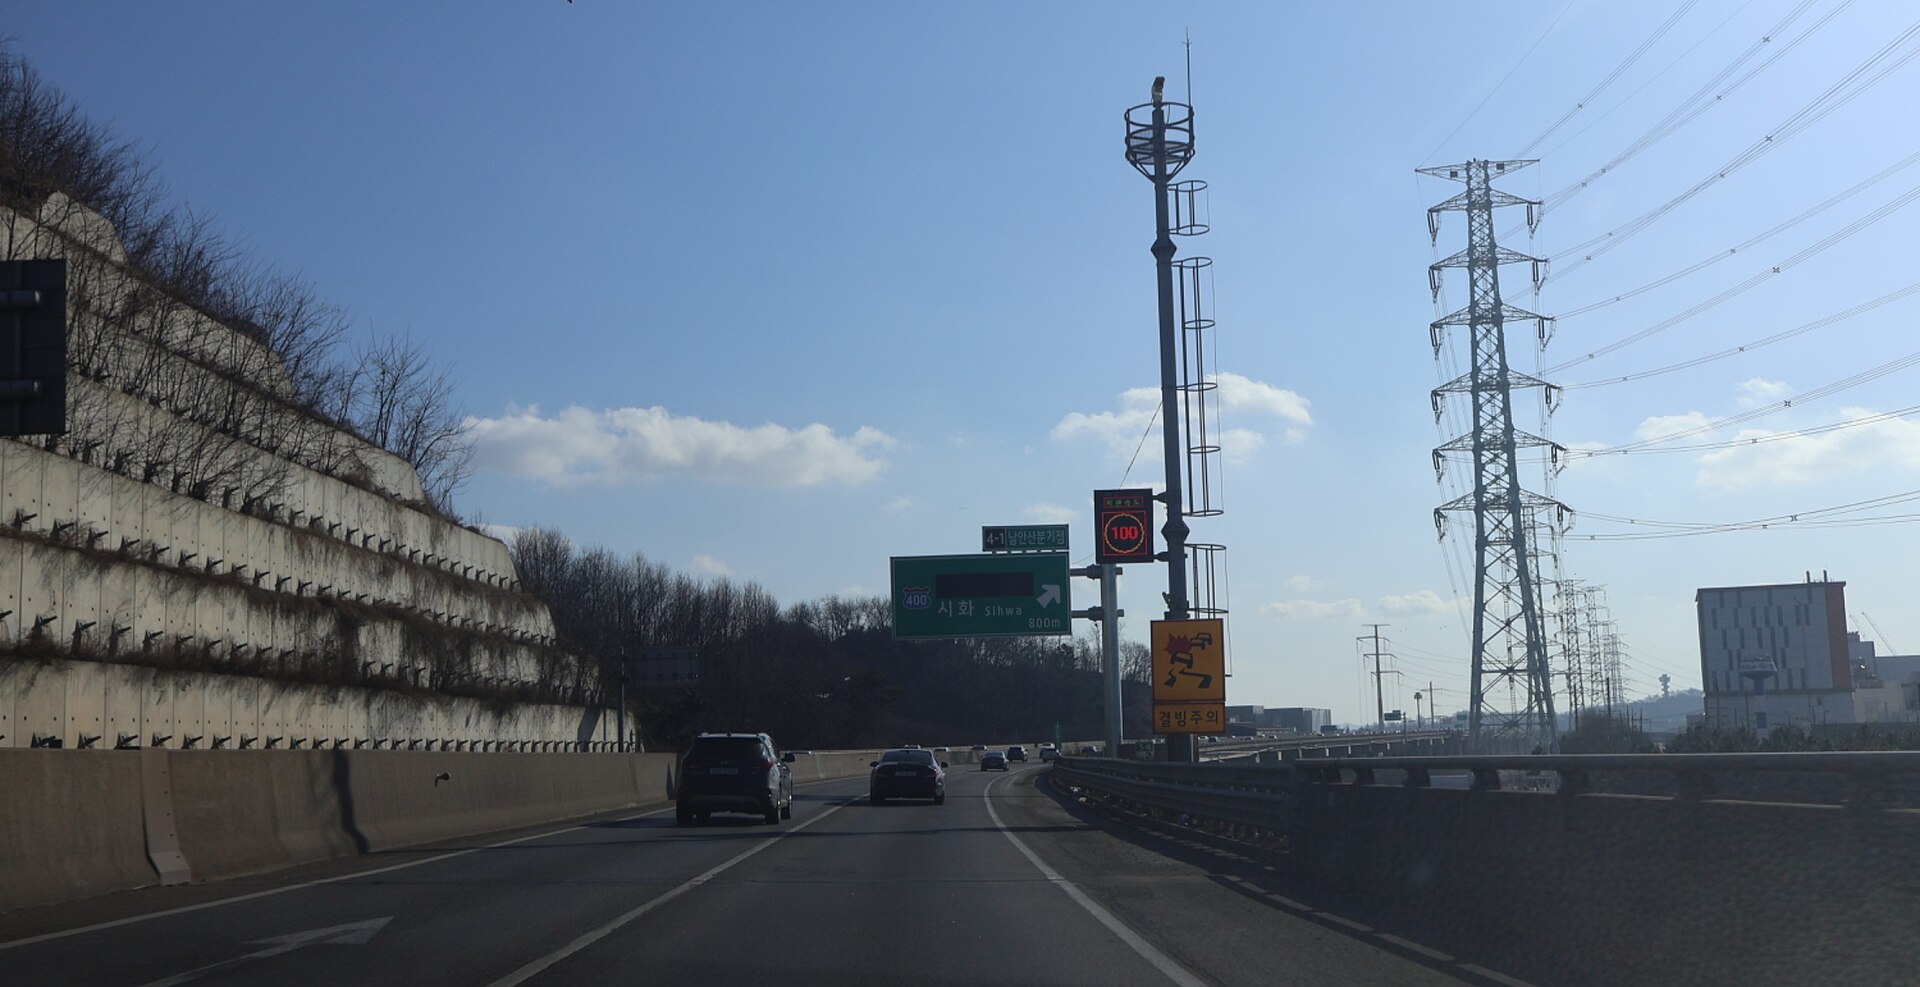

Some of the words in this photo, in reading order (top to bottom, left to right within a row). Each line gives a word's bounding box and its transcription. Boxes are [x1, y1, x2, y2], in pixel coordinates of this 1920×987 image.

[986, 532, 1005, 545] 4-1
[1008, 530, 1065, 546] 남안산분기점
[1112, 526, 1138, 540] 100
[906, 594, 927, 606] 400
[937, 600, 974, 617] 시화
[985, 606, 1023, 616] Sihwa
[1028, 618, 1061, 628] 800m
[1160, 710, 1218, 728] 결빙주의
